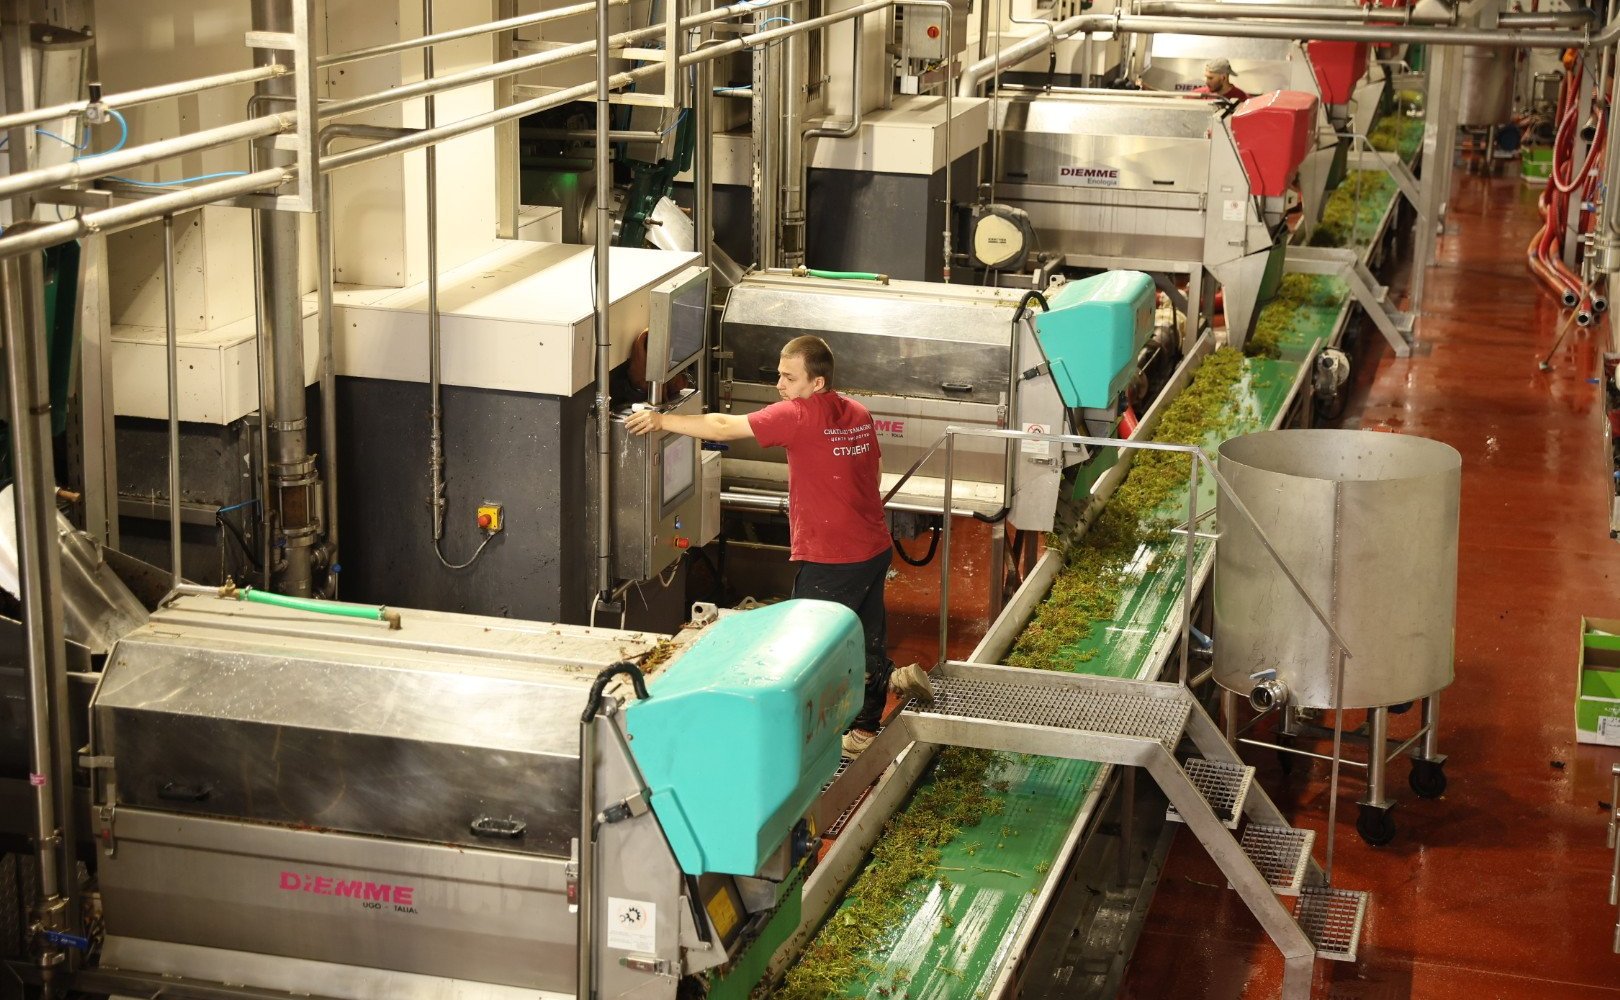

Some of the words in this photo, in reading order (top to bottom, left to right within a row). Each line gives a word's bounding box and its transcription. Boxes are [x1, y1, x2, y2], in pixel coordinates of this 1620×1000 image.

[1061, 168, 1118, 178] DIEMME
[1087, 178, 1117, 186] Enologia
[833, 443, 870, 456] СТУДЕНТ
[279, 871, 415, 905] DIEMME
[362, 901, 382, 910] UGO
